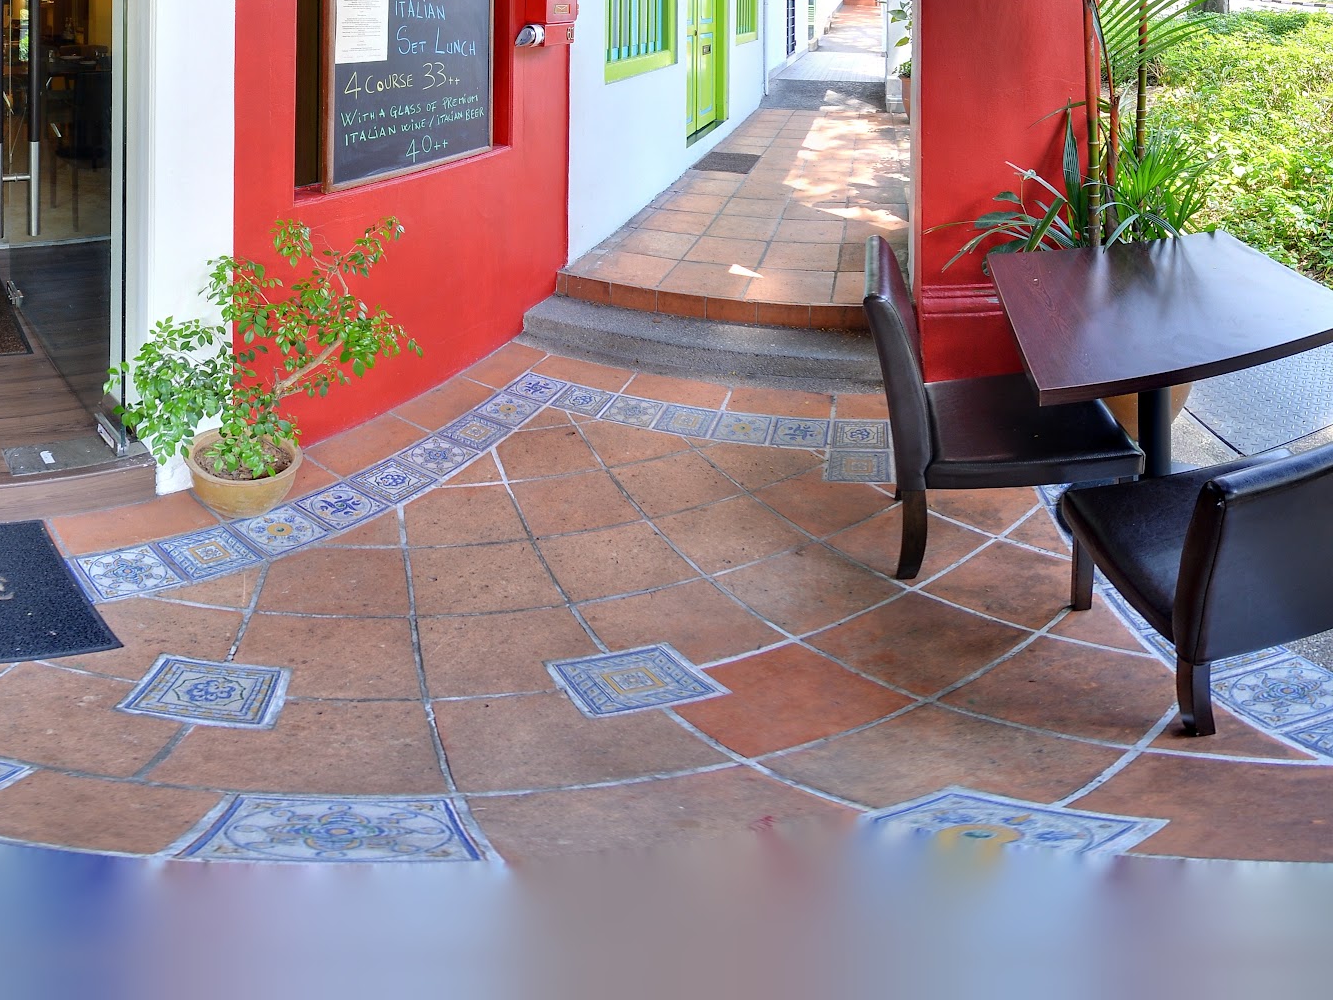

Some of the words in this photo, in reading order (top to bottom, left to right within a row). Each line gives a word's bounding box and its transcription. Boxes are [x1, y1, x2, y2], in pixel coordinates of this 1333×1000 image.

[344, 71, 362, 100] 4
[378, 108, 386, 118] A
[390, 103, 421, 118] GLASS
[426, 100, 437, 113] OF
[465, 107, 485, 121] BEER
